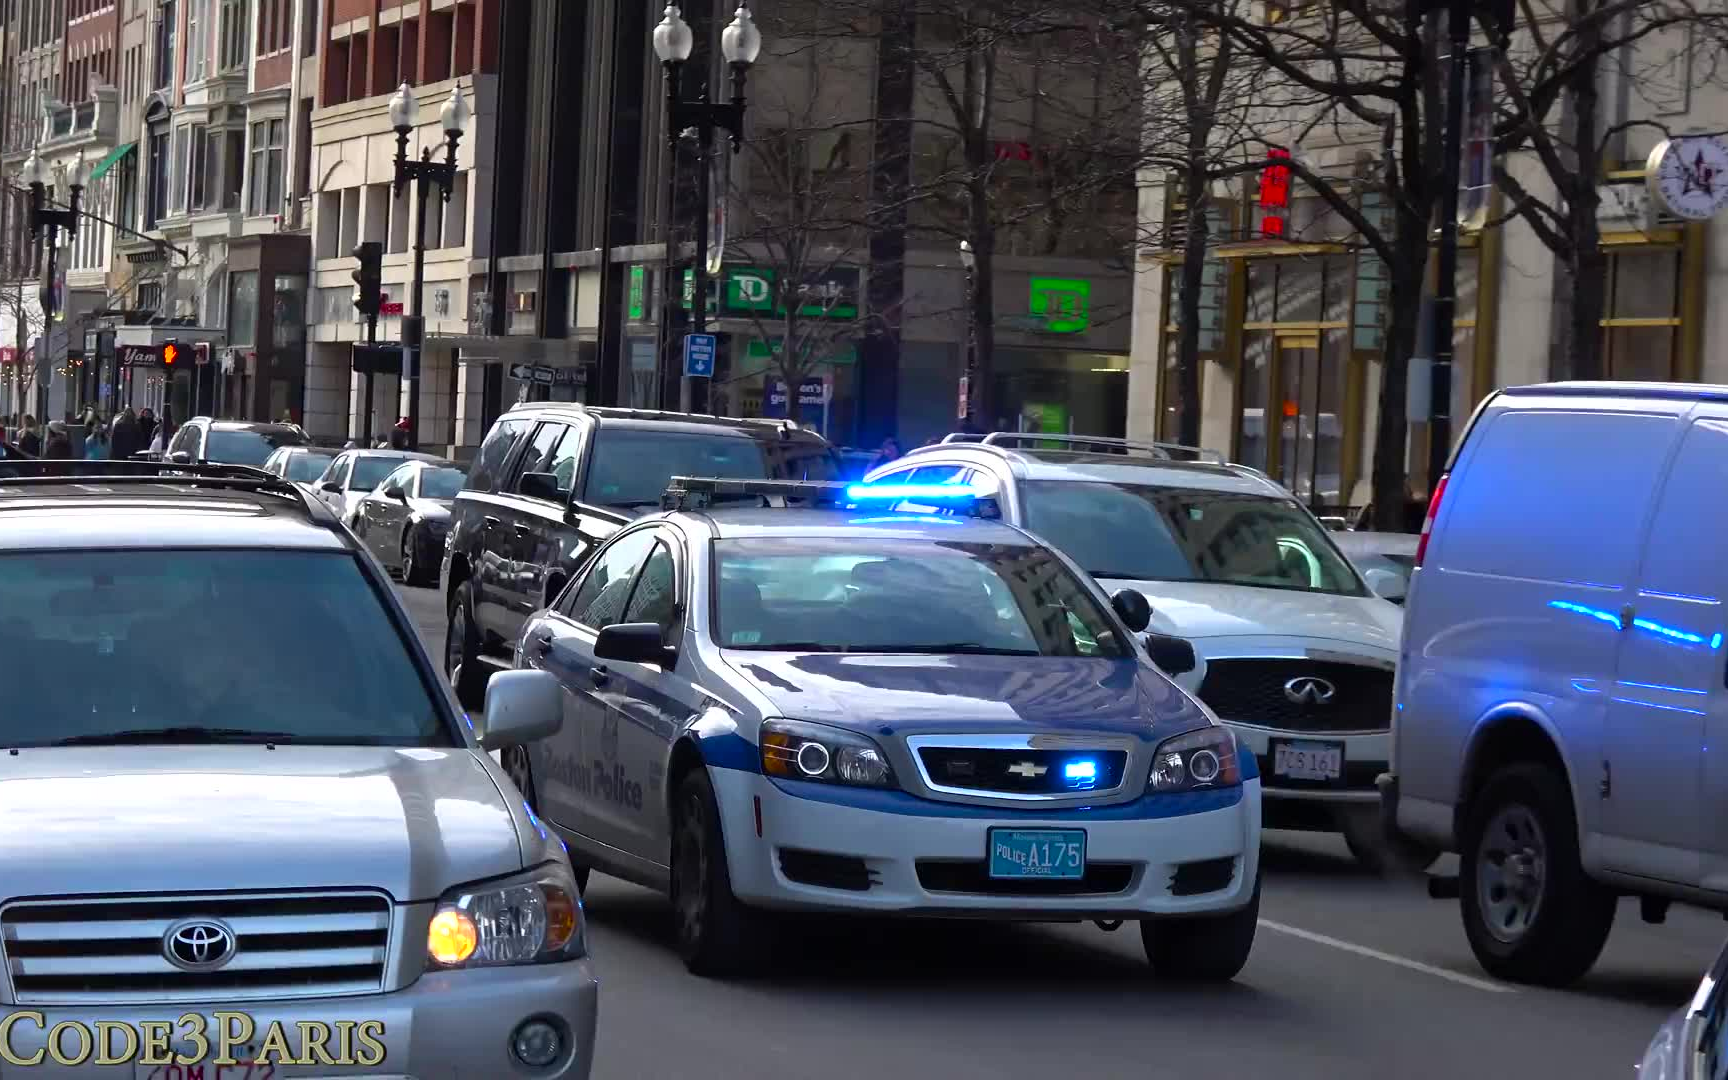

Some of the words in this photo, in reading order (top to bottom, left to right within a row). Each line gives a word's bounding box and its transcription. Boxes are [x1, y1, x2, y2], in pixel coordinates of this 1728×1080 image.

[732, 275, 769, 303] TD
[594, 758, 643, 812] Police
[996, 843, 1027, 866] POLICE
[1028, 842, 1080, 867] A175
[1022, 866, 1052, 874] OFFICIAL
